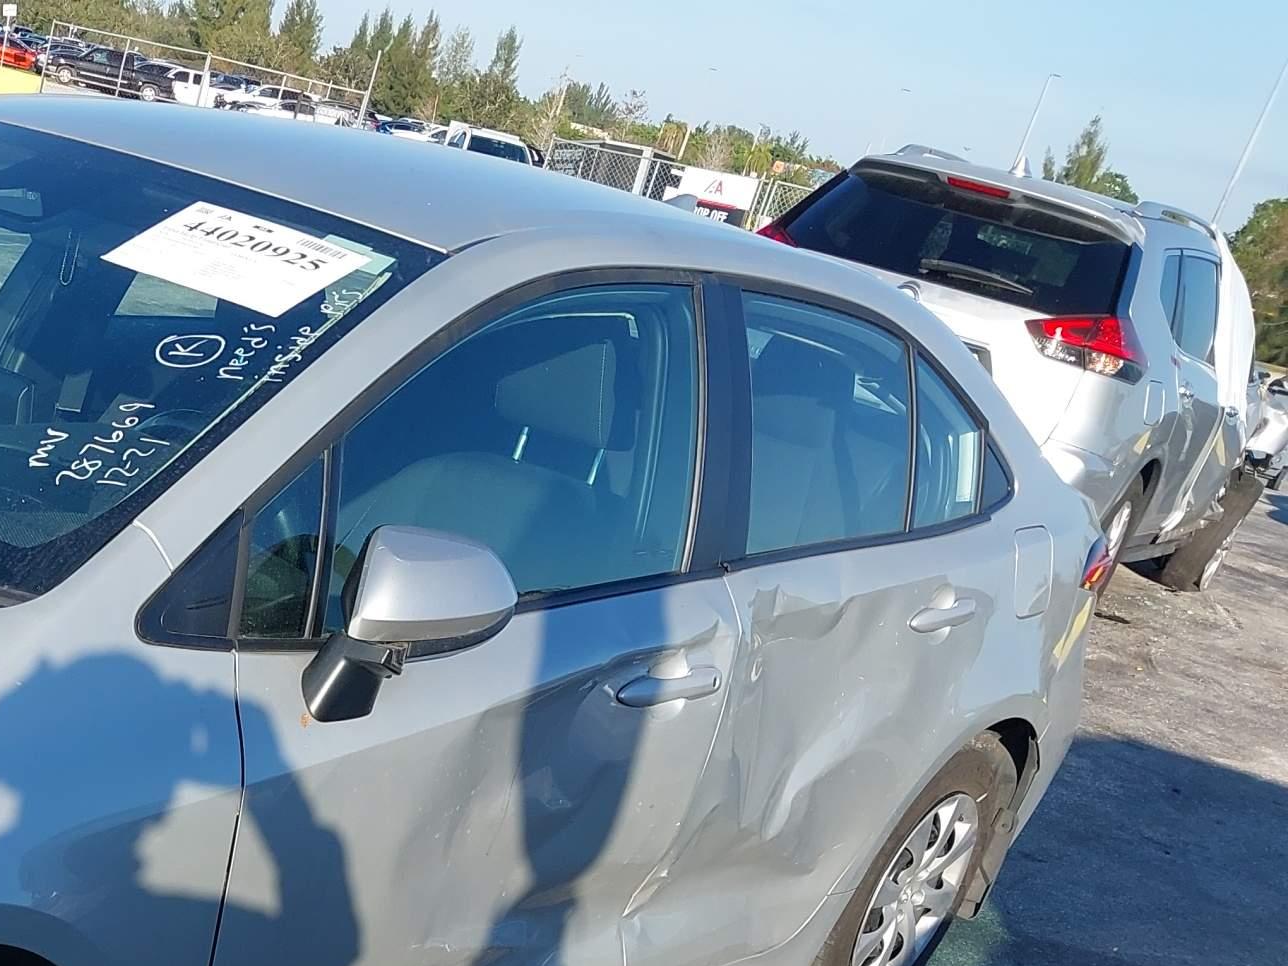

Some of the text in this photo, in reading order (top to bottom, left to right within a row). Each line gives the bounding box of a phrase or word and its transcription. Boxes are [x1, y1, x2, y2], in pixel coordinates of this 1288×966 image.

[183, 221, 329, 272] 44020925
[55, 402, 156, 486] 287669
[95, 436, 171, 487] 12-21
